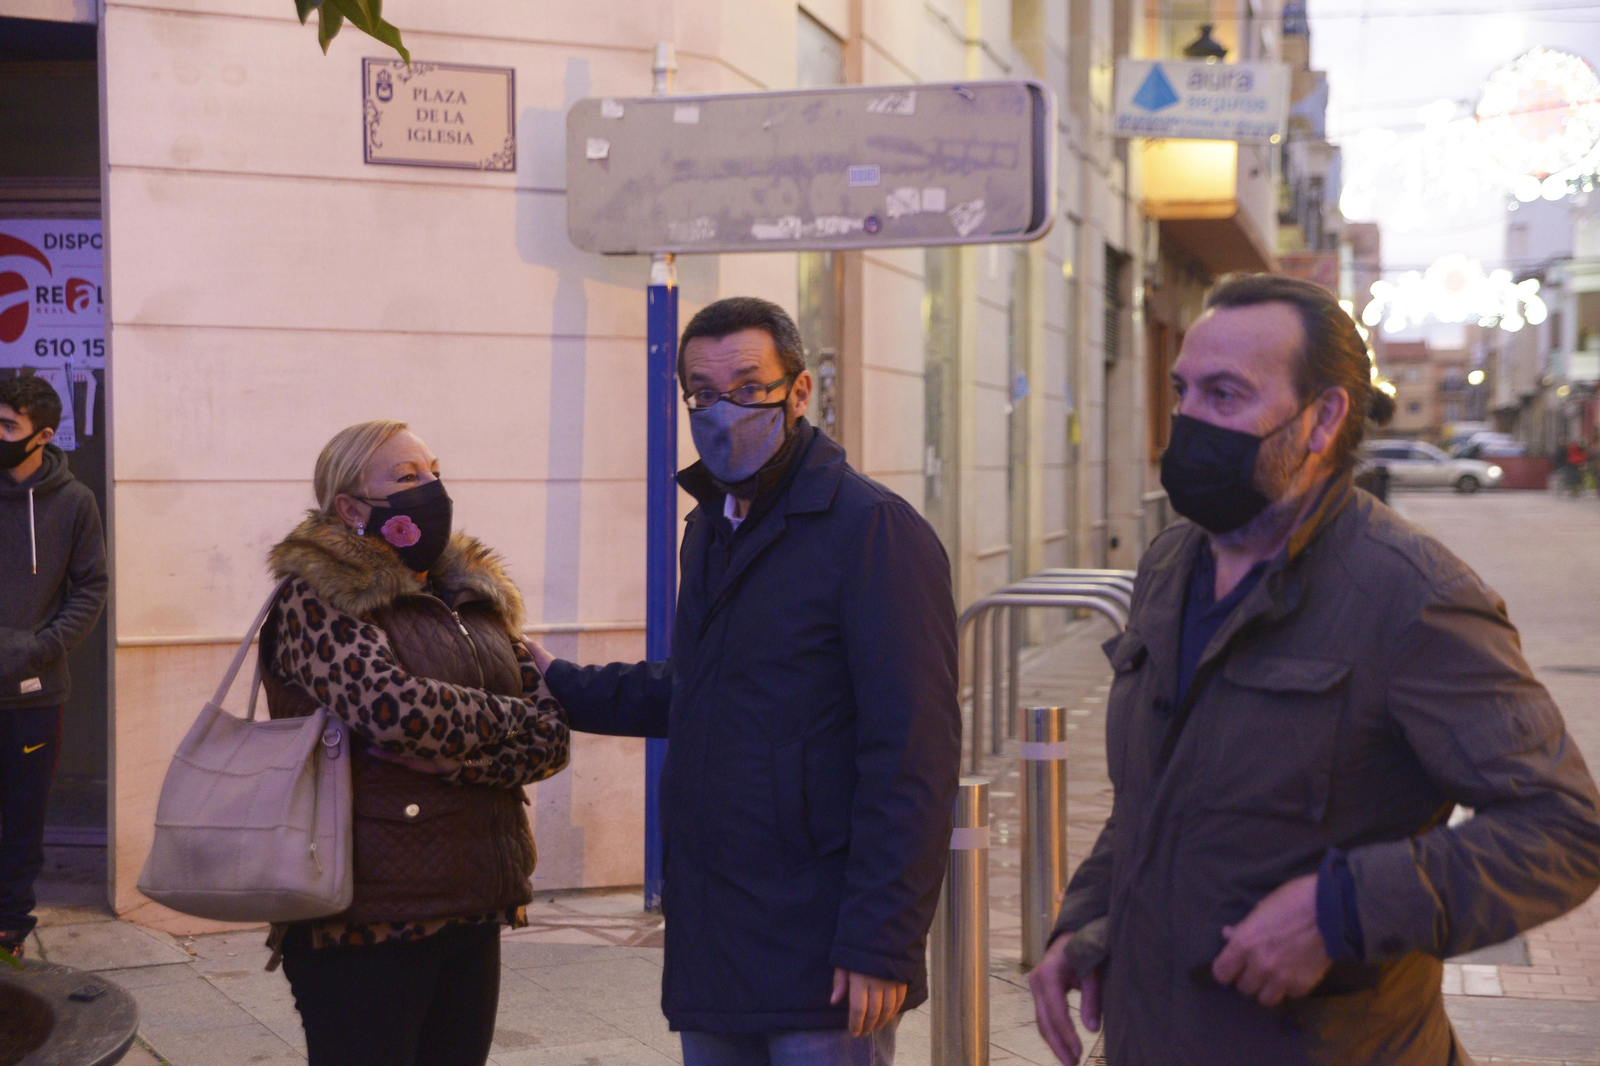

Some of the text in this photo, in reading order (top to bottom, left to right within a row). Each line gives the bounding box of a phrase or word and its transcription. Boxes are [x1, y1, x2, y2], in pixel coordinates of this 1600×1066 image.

[413, 87, 467, 105] PLAZA
[417, 109, 464, 124] DE LA
[408, 128, 474, 145] IGLESIA
[35, 338, 105, 357] 610 15
